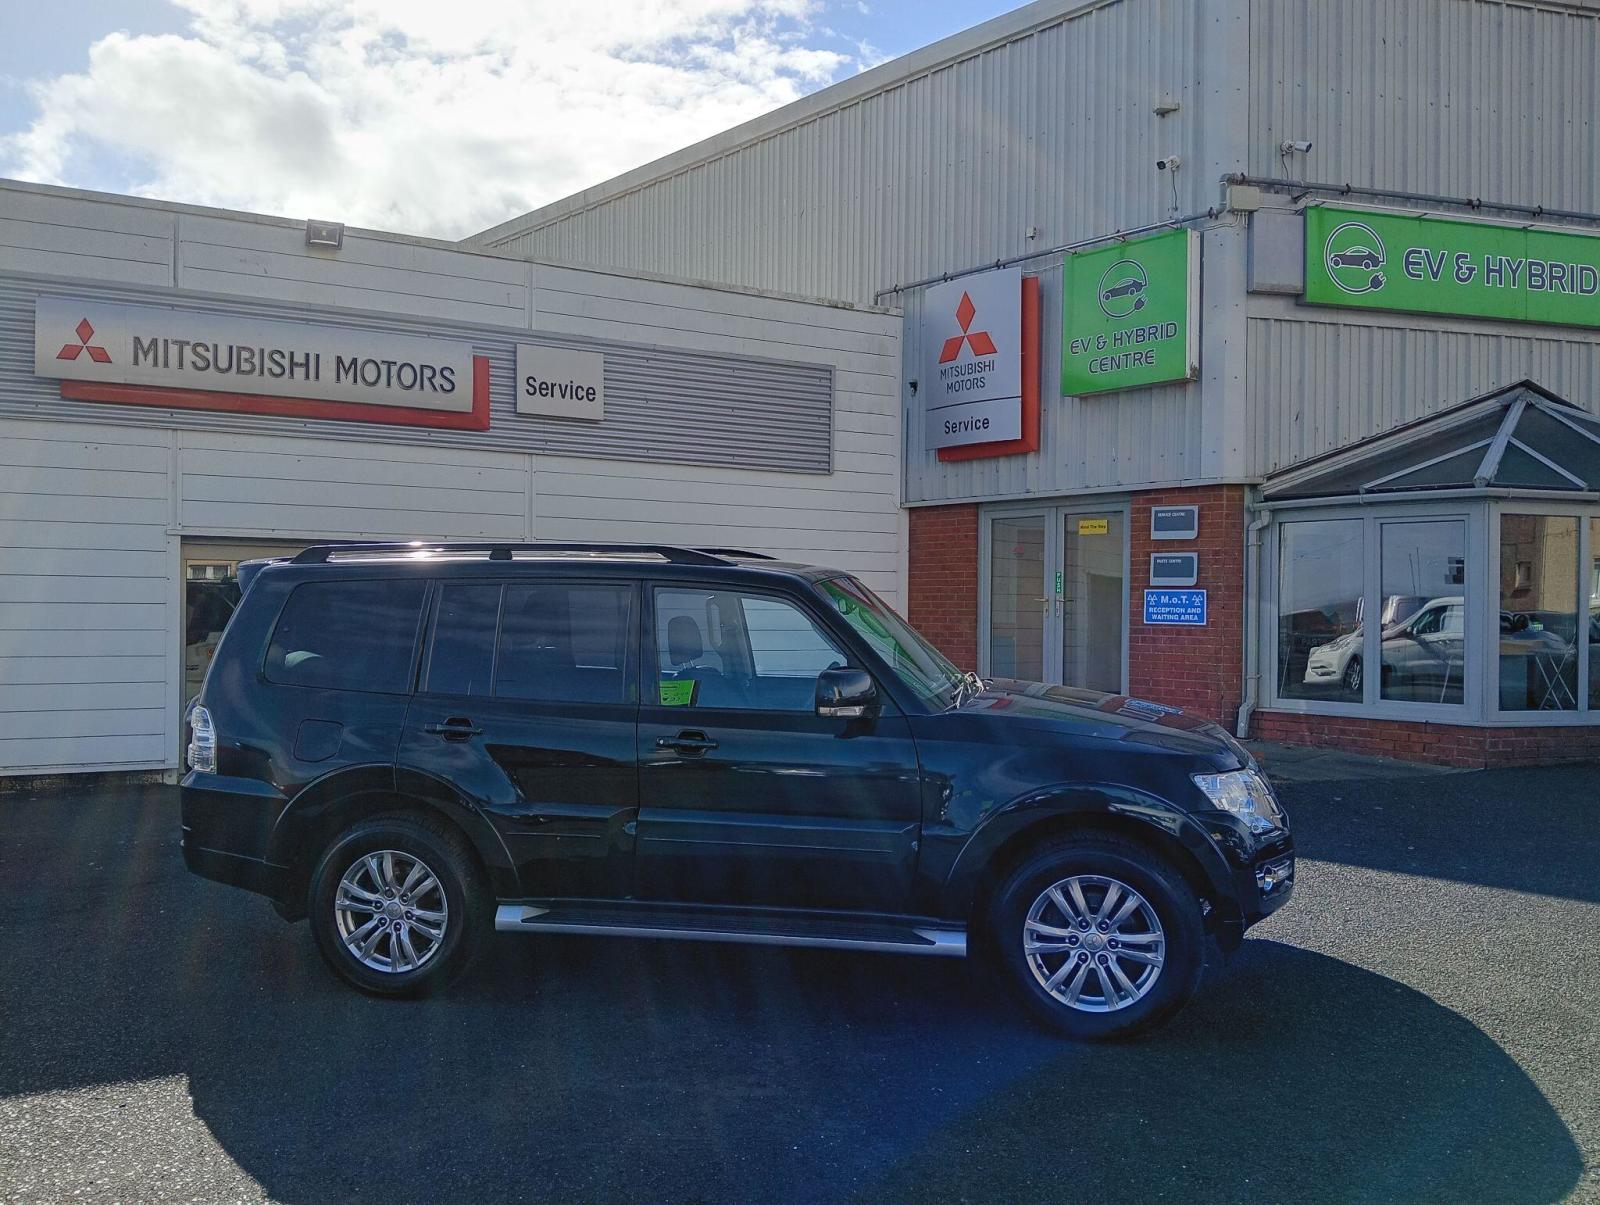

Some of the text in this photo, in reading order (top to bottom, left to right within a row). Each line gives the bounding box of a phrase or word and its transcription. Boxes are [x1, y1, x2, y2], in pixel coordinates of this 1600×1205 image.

[1403, 248, 1599, 296] EV & HYBRID
[1070, 322, 1178, 354] EV & HYBRID
[132, 336, 457, 393] MITSUBISHI MOTORS
[940, 360, 995, 380] MITSUBISHI
[1088, 349, 1155, 374] CENTRE
[525, 376, 597, 402] Service
[946, 377, 986, 394] MOTORS
[944, 417, 990, 434] Service
